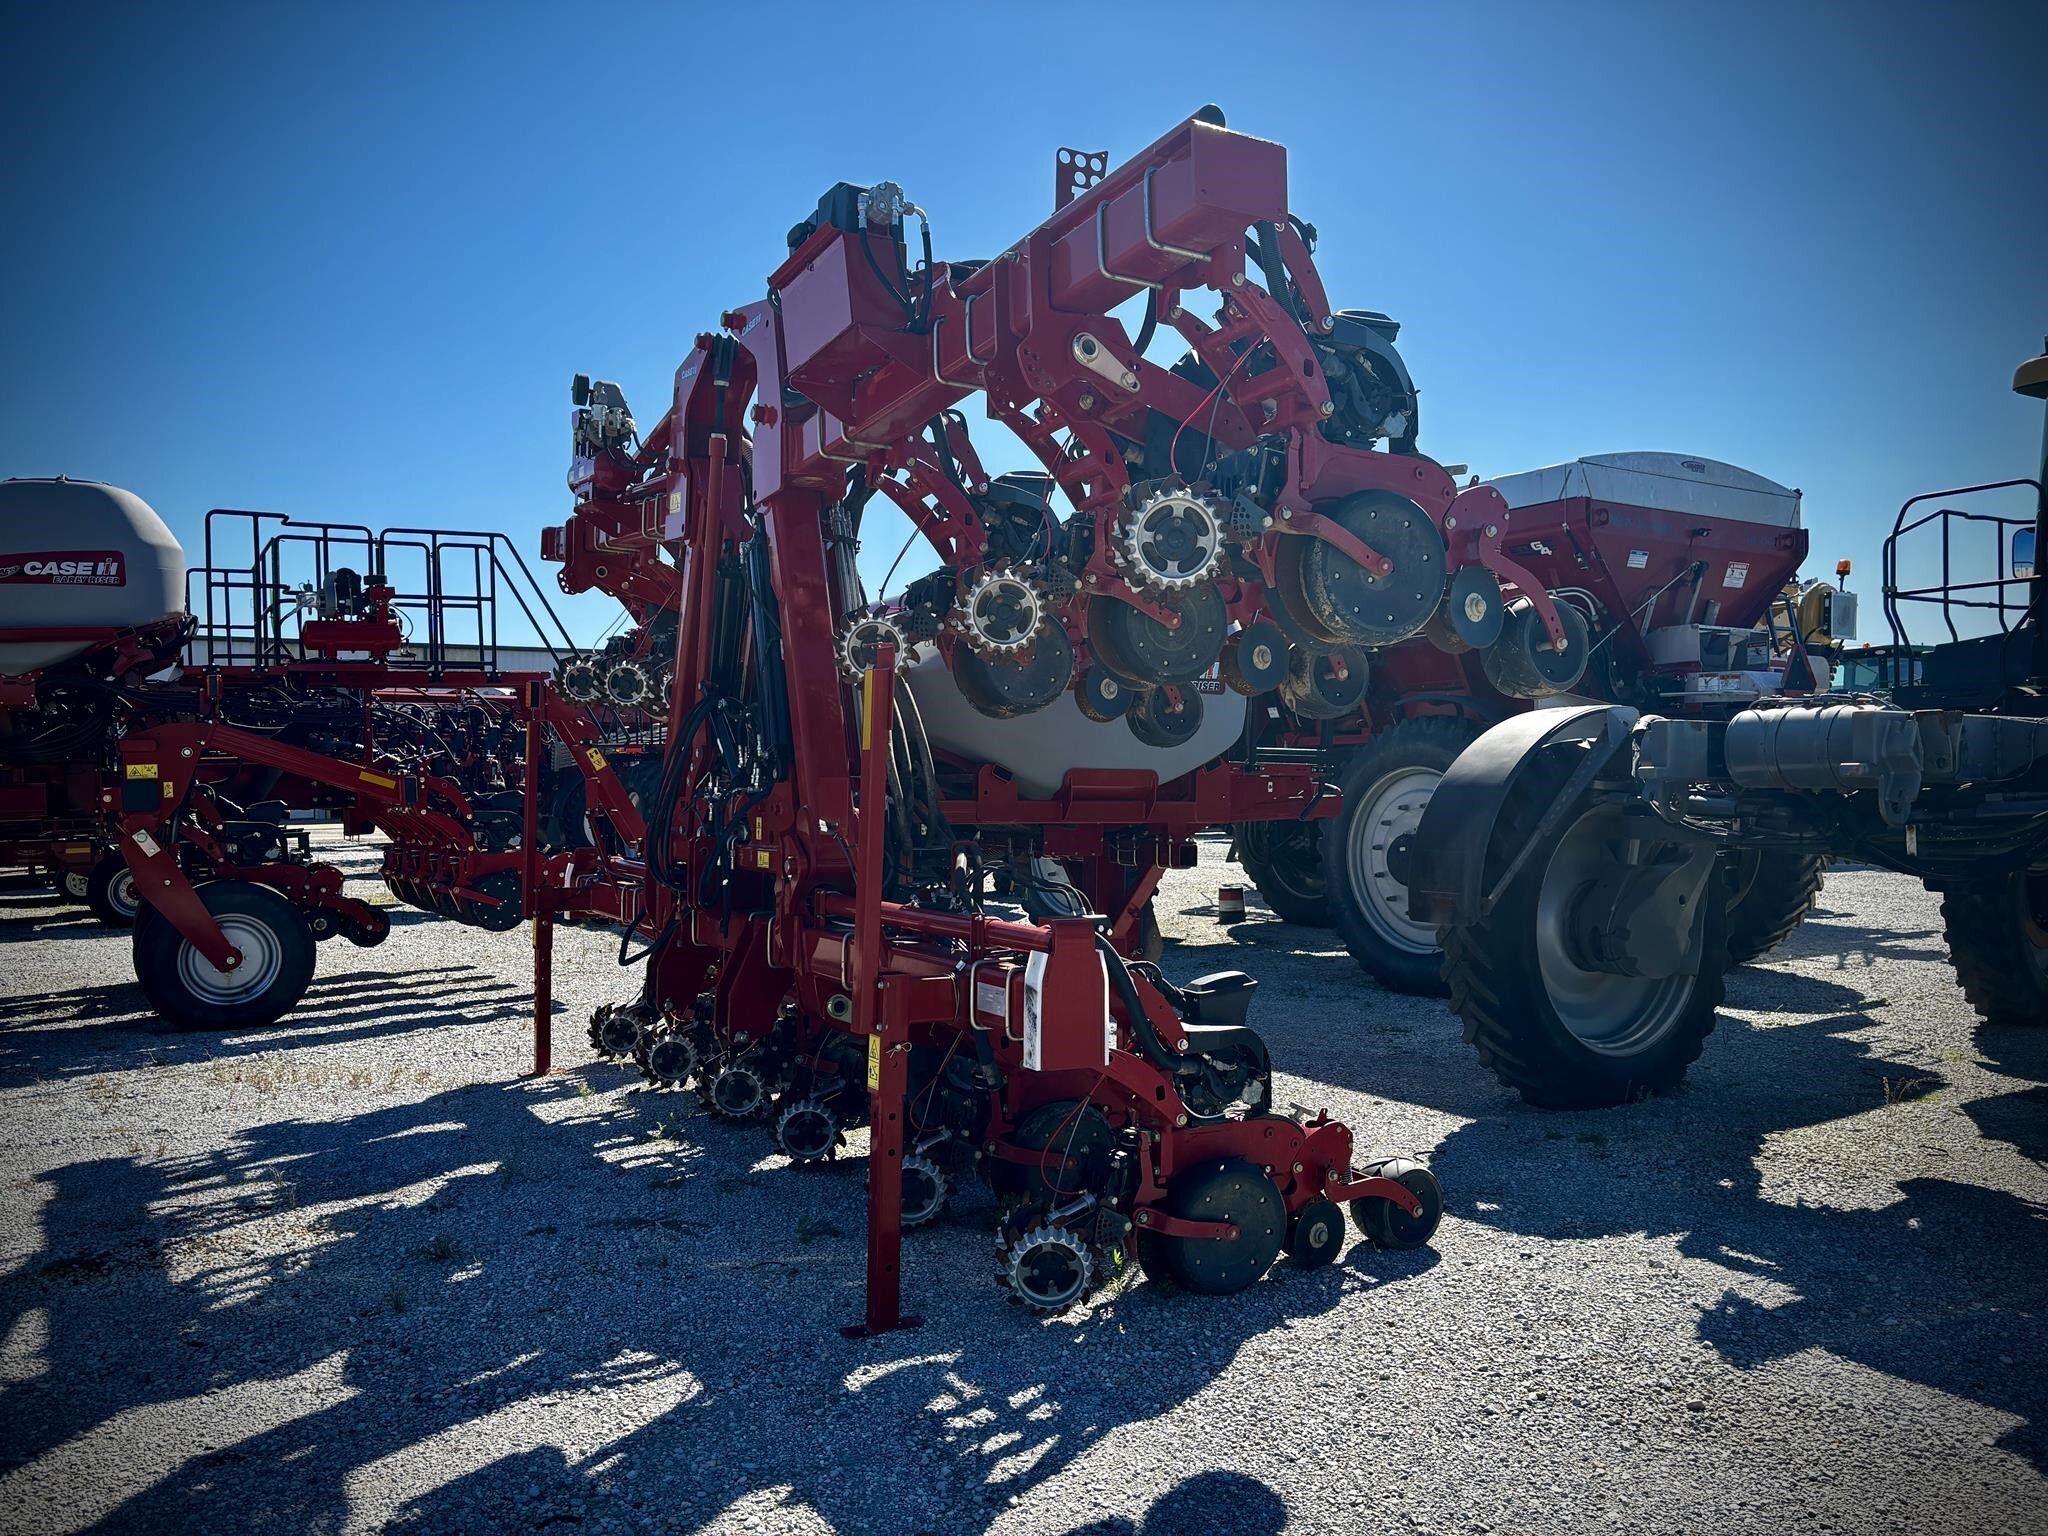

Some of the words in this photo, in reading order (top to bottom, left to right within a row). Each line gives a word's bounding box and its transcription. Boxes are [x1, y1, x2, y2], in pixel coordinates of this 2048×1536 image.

[1530, 541, 1553, 556] G4
[23, 561, 94, 576] CASE
[96, 558, 119, 576] IH
[53, 576, 88, 584] EARLY
[88, 576, 121, 585] RISER
